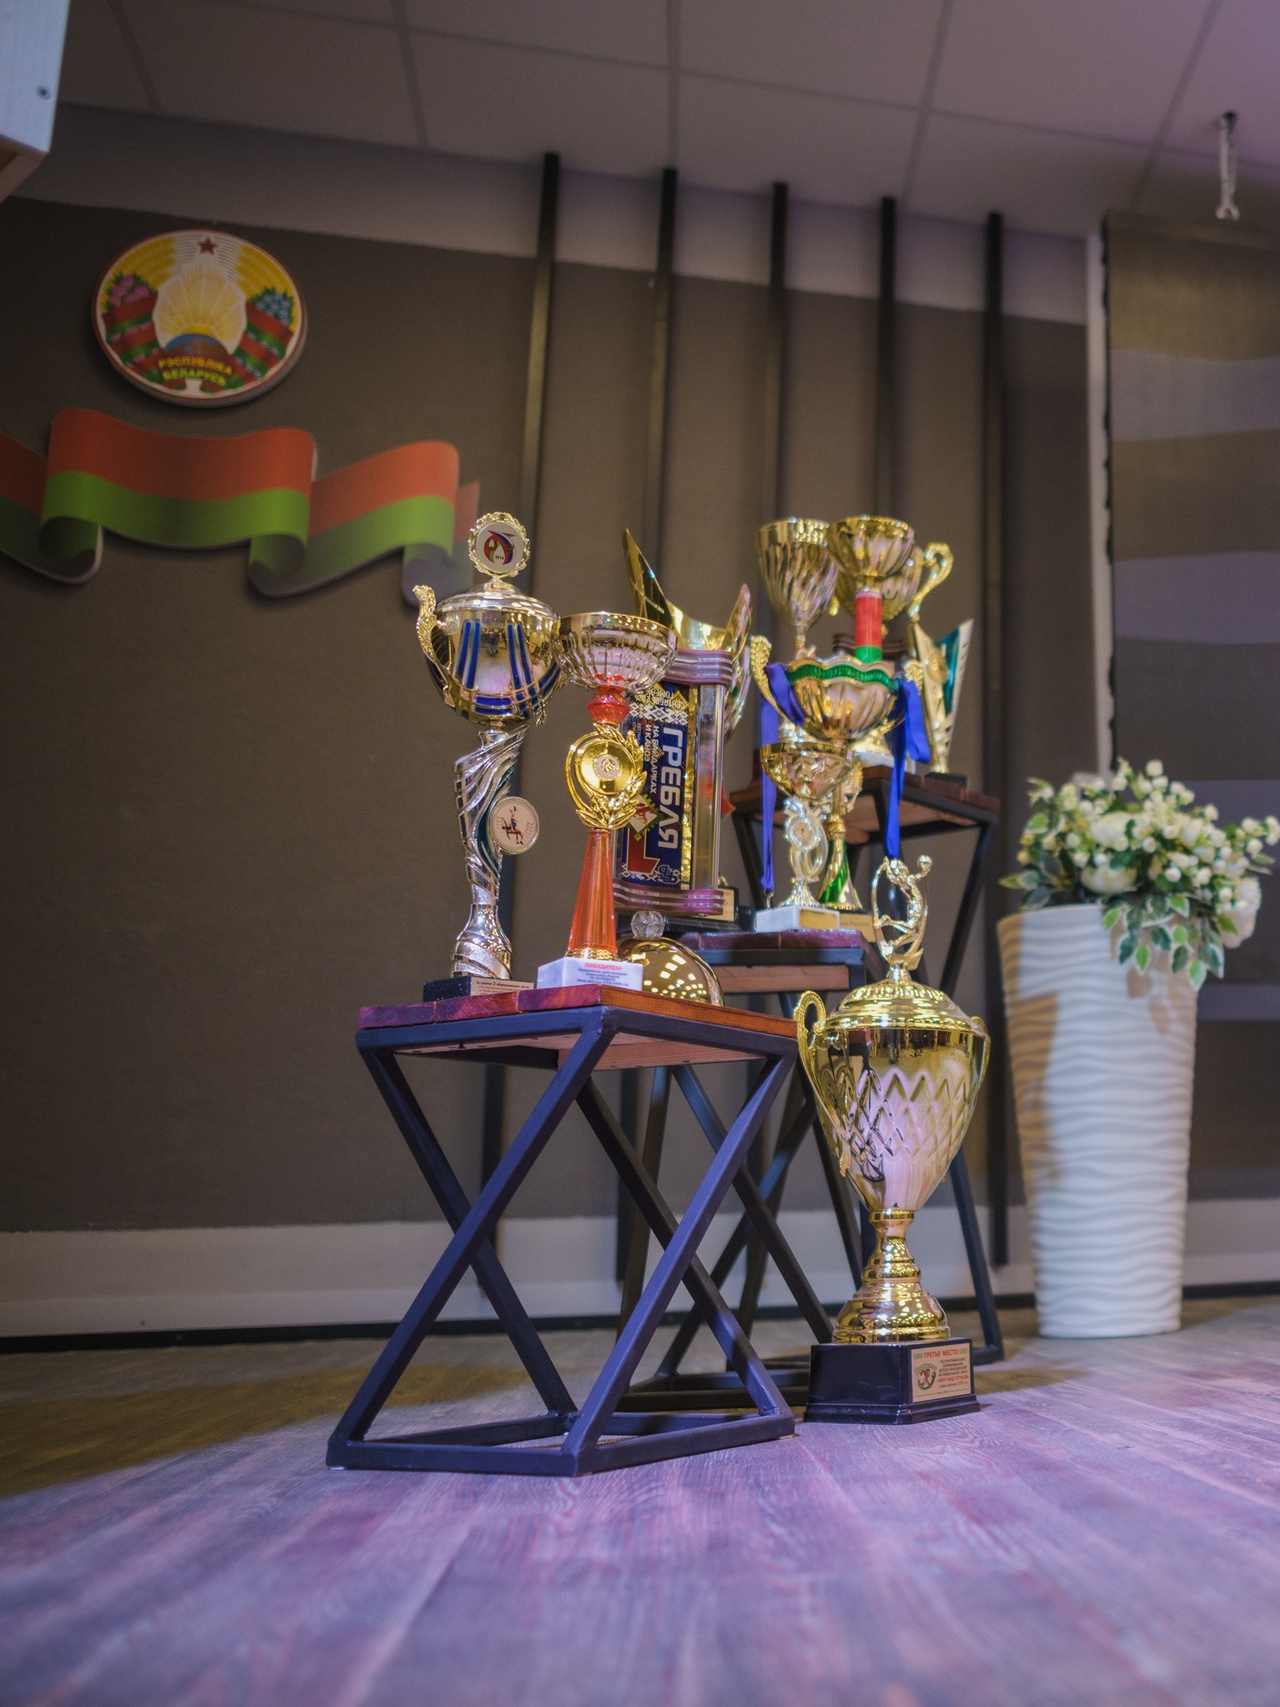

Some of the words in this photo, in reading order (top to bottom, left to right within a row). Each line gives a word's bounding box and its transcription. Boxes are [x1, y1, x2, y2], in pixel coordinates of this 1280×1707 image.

[644, 732, 652, 762] КАНОЭ
[652, 725, 660, 738] НА
[649, 739, 660, 794] БАЙДАРКАХ
[657, 726, 684, 850] ГРЕБЛЯ
